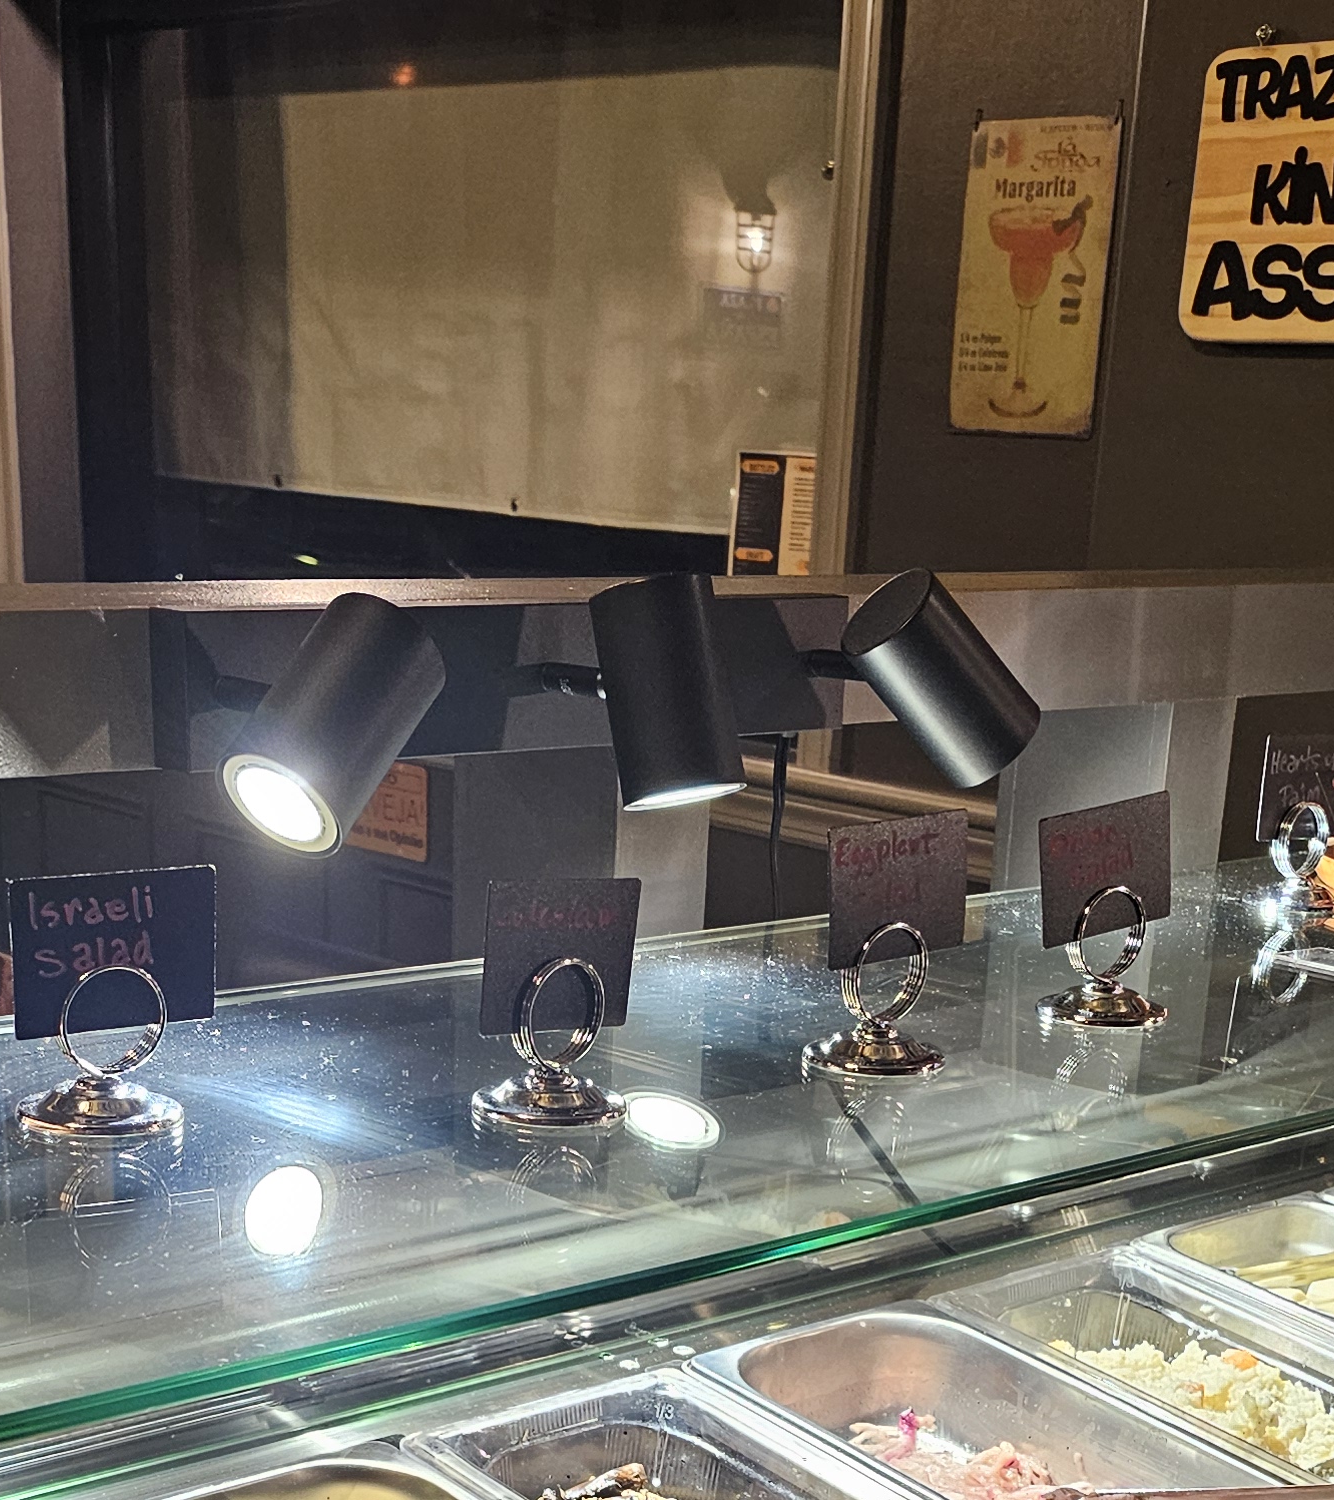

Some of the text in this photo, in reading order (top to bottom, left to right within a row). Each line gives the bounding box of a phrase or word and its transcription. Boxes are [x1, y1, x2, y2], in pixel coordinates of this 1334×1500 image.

[995, 175, 1077, 204] Margarita
[1270, 745, 1321, 775] Hearts
[27, 885, 155, 931] Israeli
